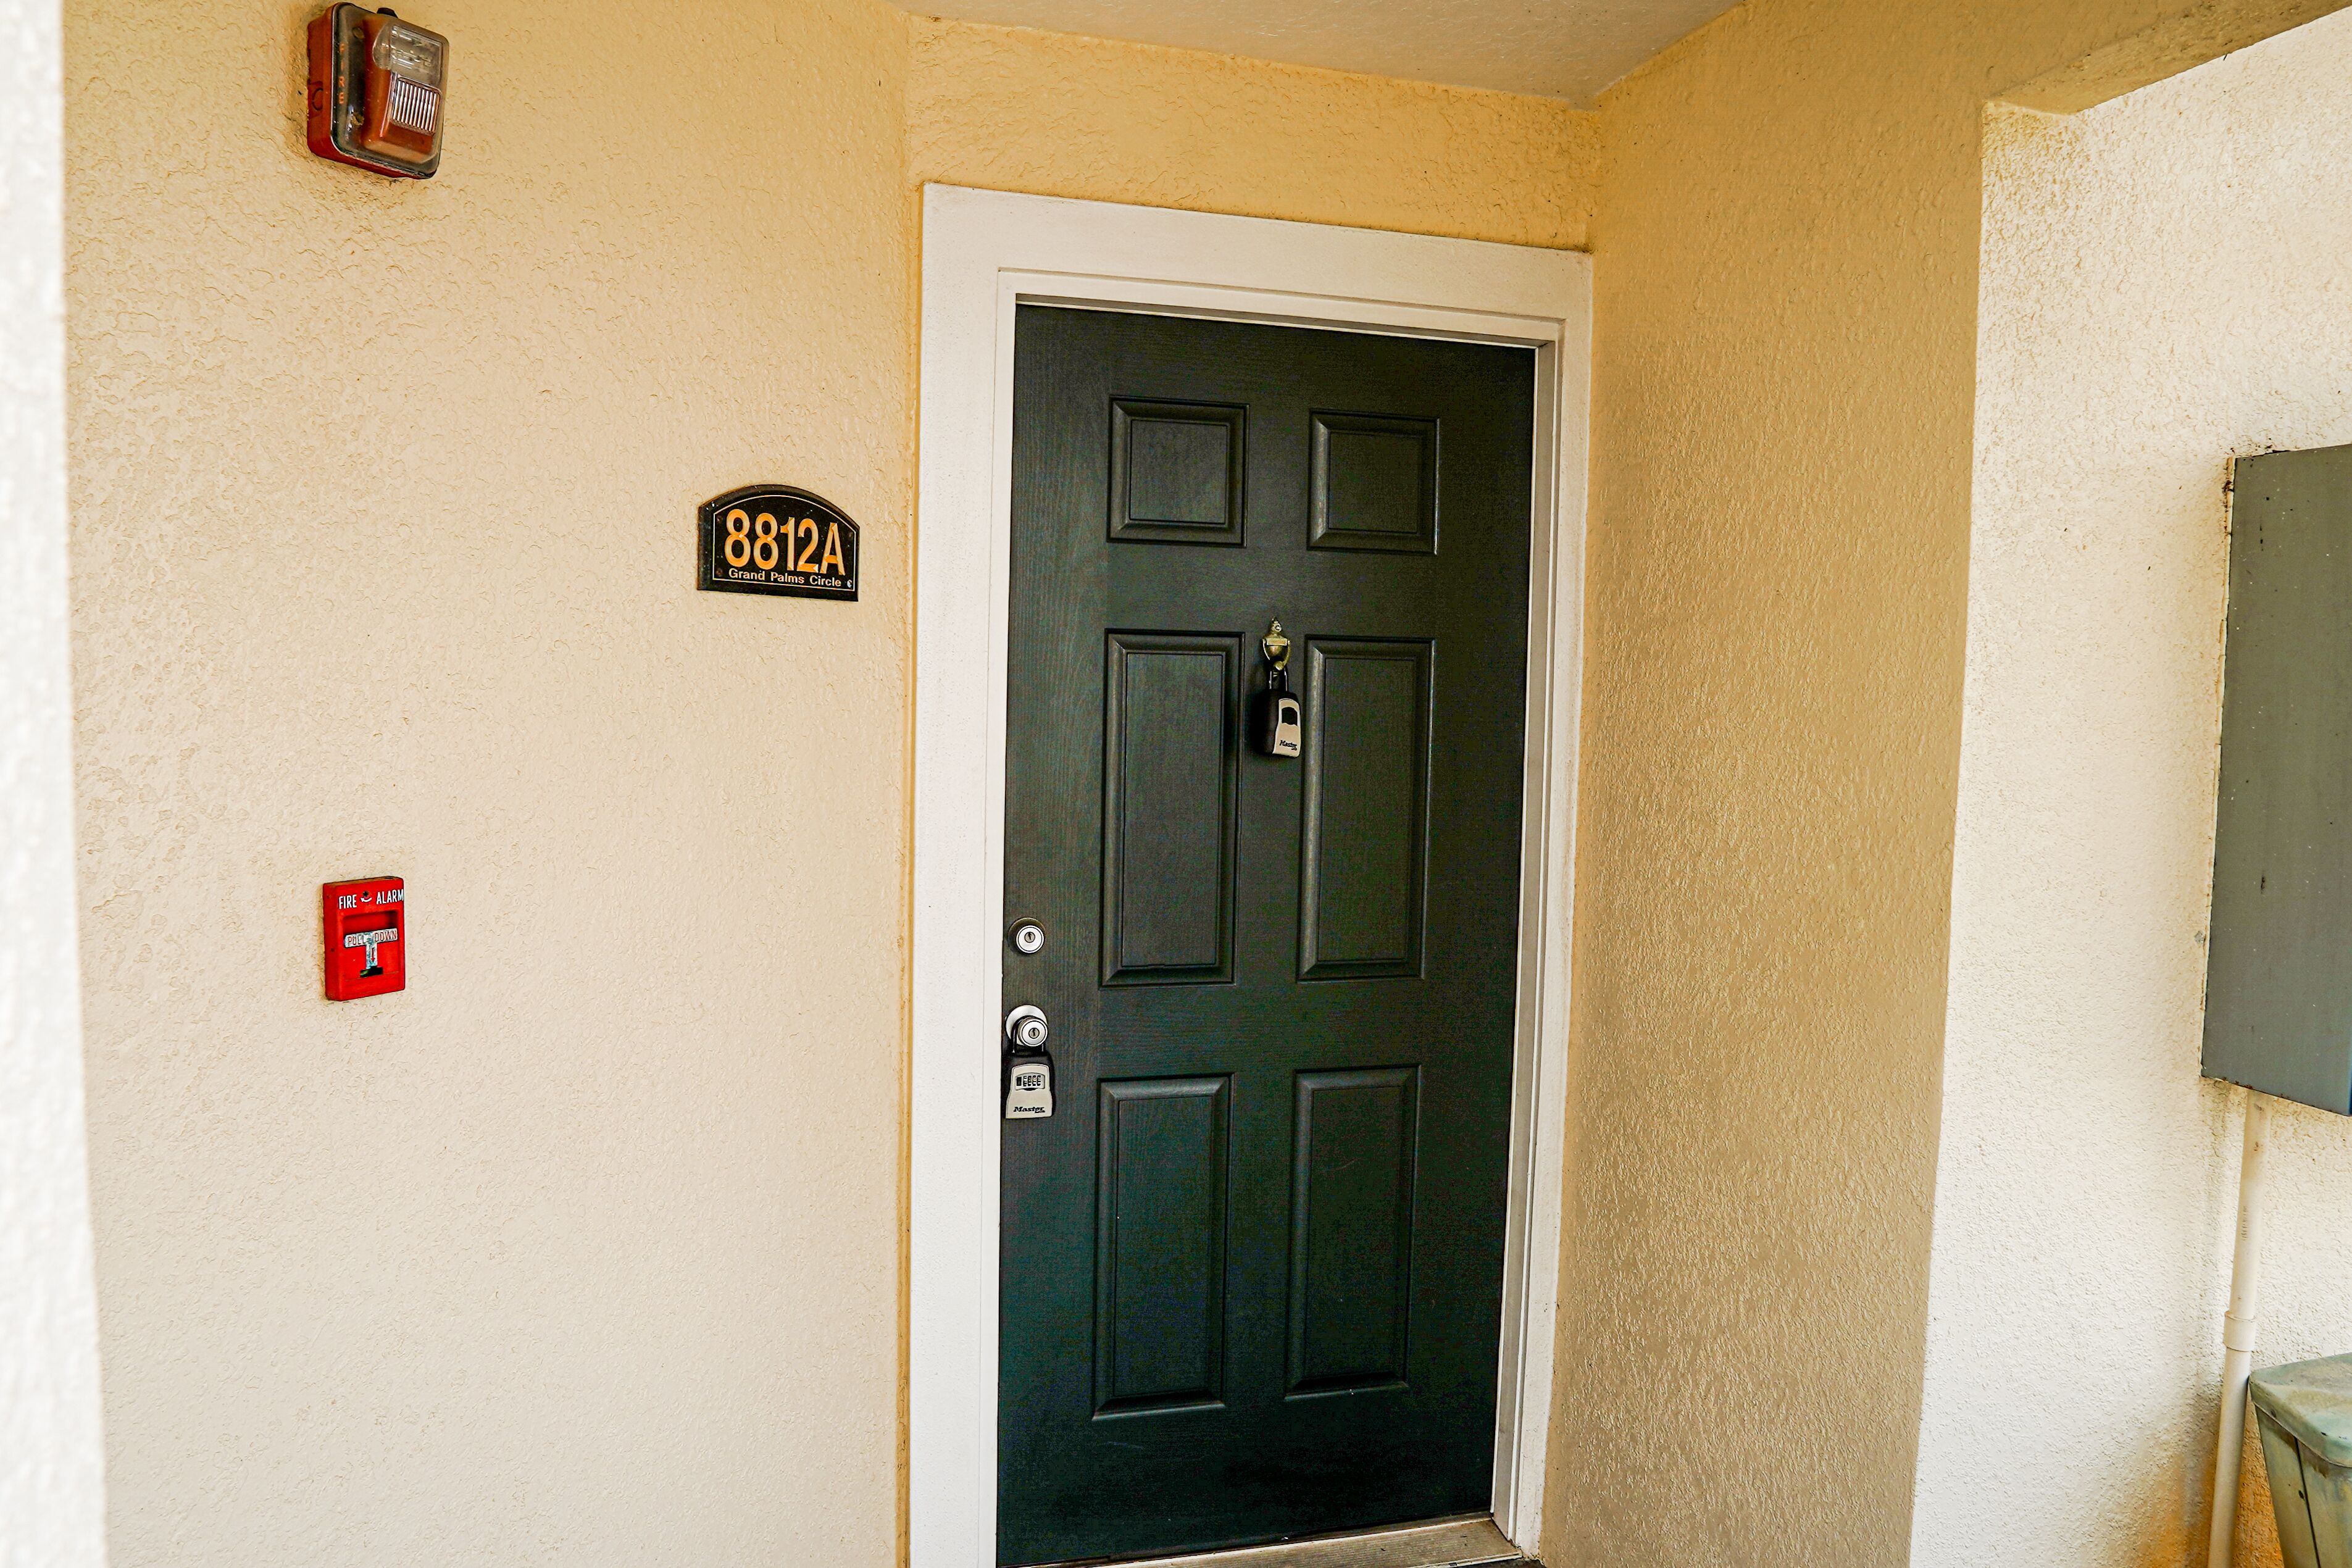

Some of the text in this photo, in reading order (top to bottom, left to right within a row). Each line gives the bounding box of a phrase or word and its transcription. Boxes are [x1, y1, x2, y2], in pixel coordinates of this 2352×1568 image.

[724, 509, 845, 575] 8812A
[728, 568, 841, 587] Grand Palms Circle
[338, 888, 404, 909] FIRE ALARM
[347, 930, 397, 946] PULL DOWN
